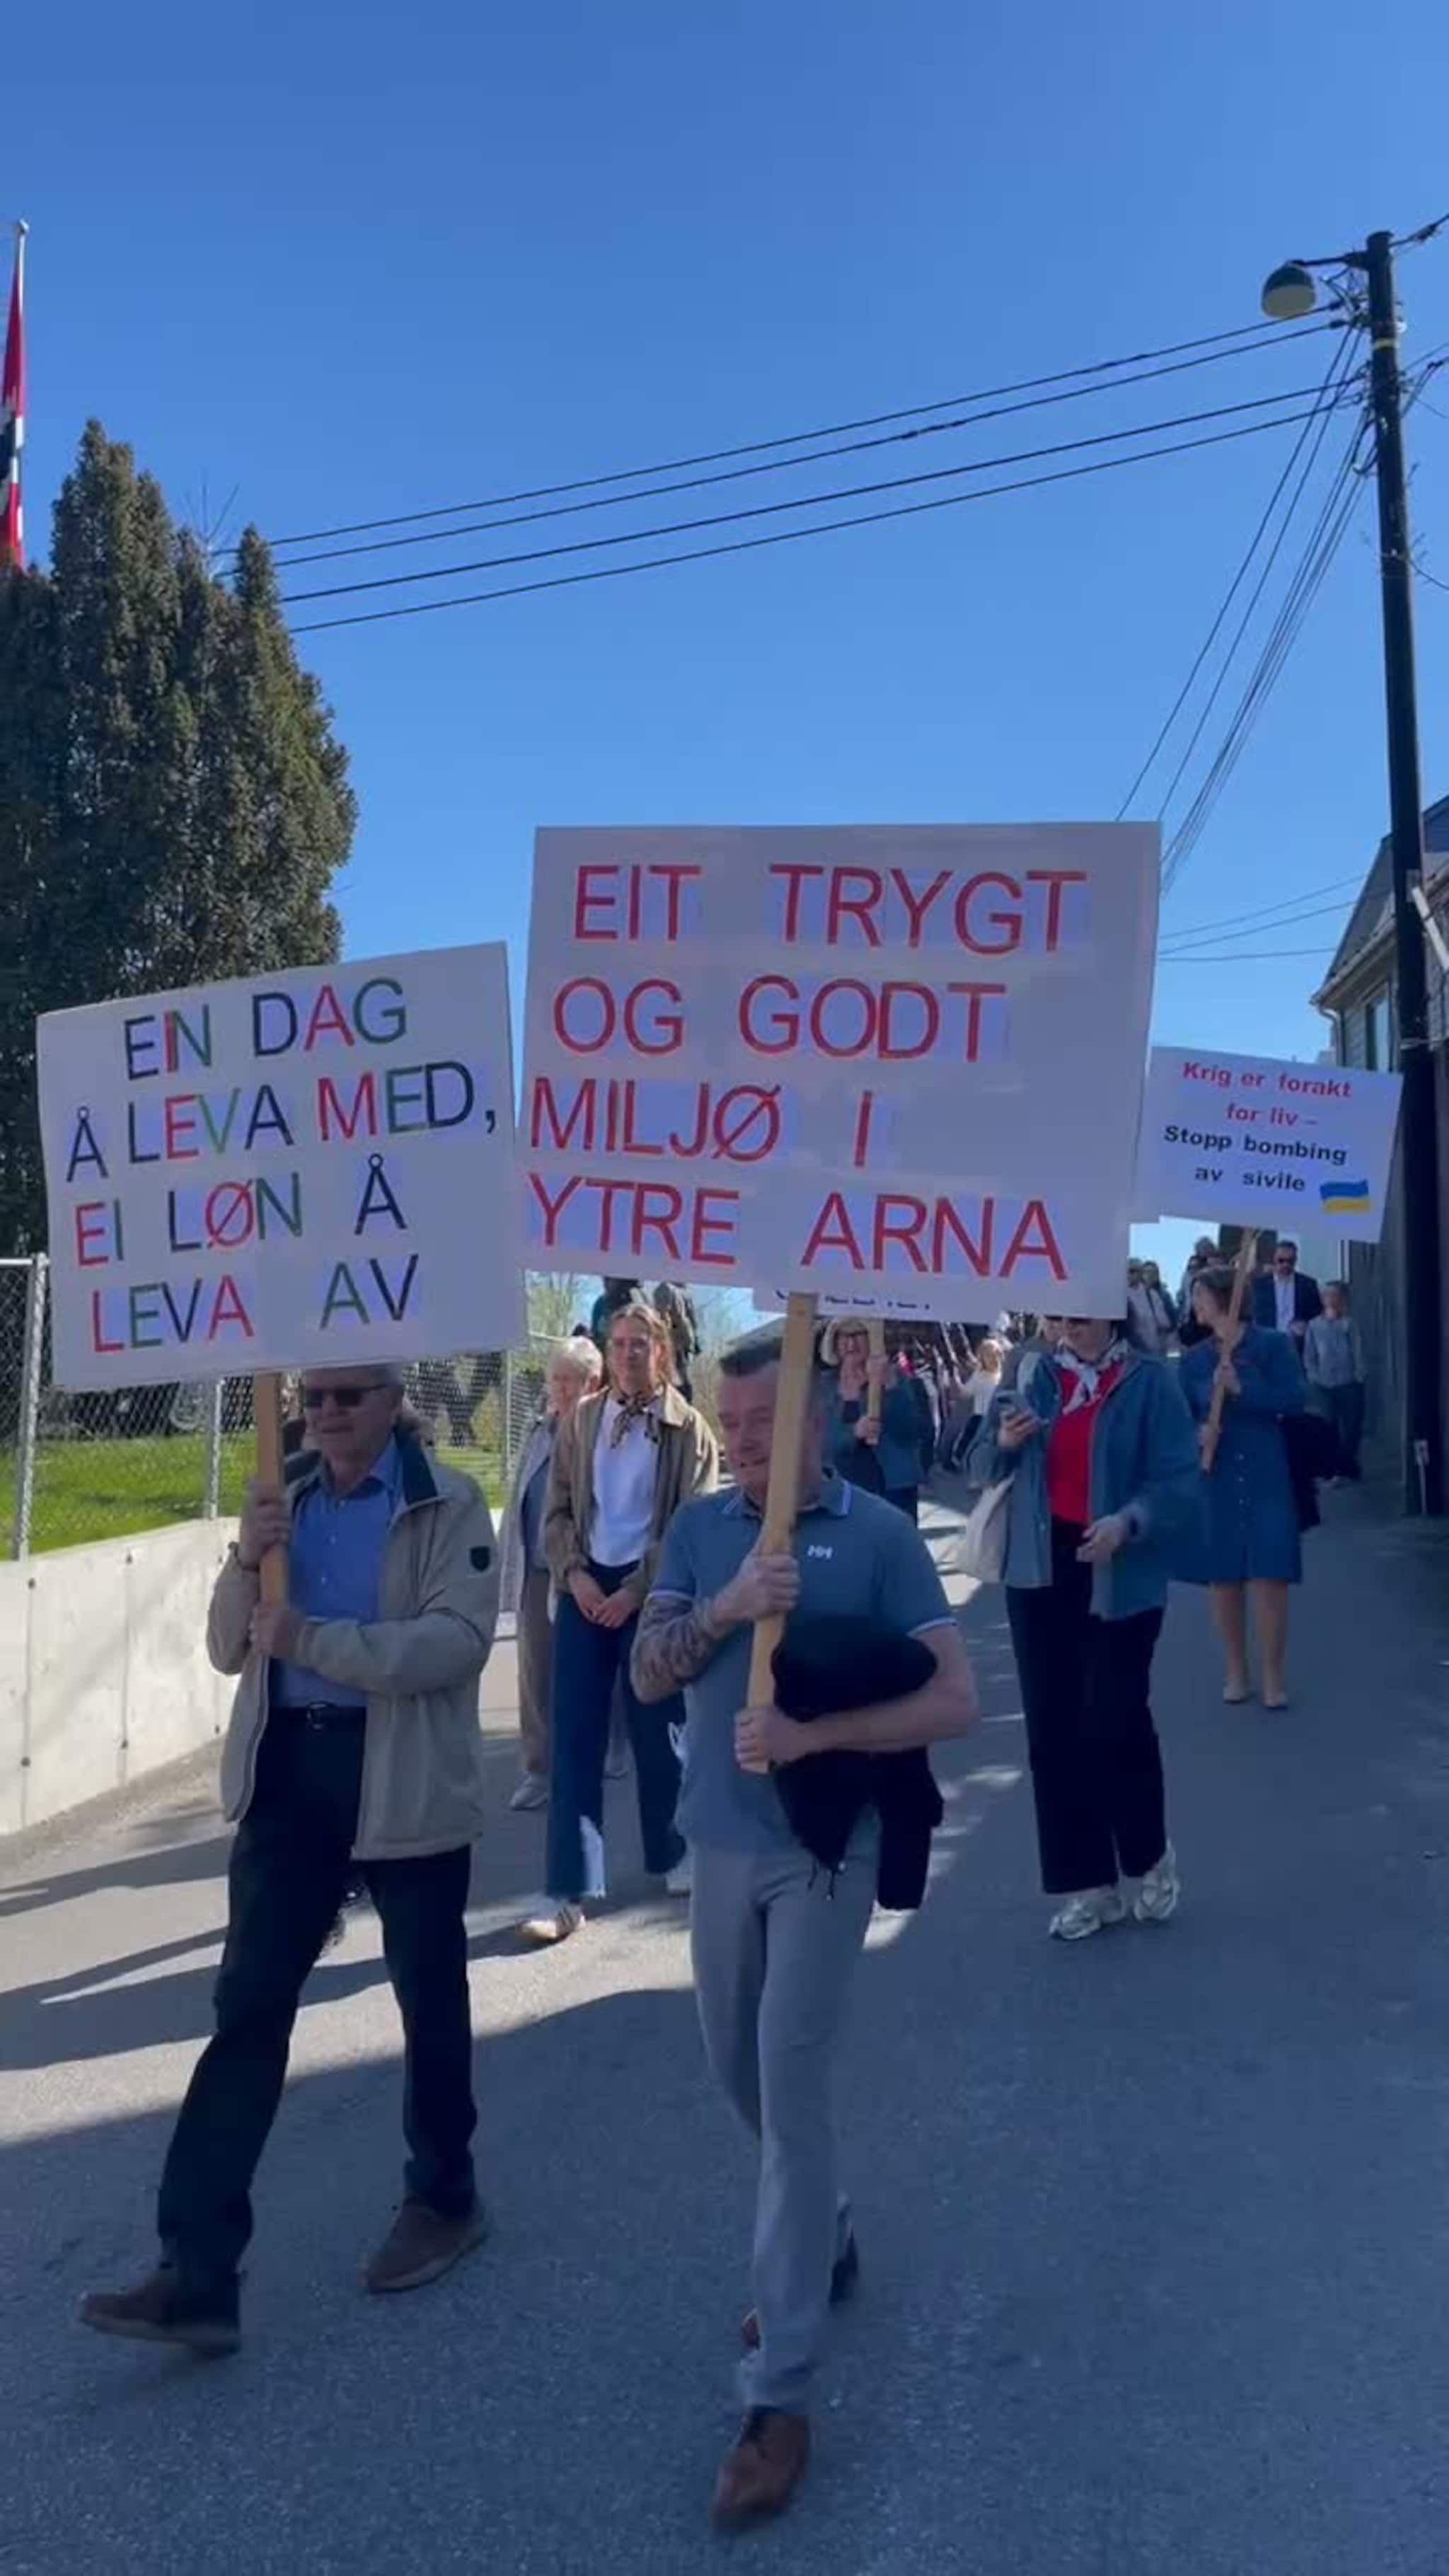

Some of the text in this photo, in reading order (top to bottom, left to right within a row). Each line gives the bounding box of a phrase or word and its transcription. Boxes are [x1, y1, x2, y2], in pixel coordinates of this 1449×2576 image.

[573, 864, 1088, 956] EIT TRYGT
[123, 977, 408, 1082] EIN DAG
[552, 974, 1007, 1063] OG GODT
[66, 1061, 496, 1182] Å LEVA MED,
[530, 1076, 874, 1169] MILJØ I
[1182, 1061, 1353, 1098] Krig er forakt
[1225, 1102, 1261, 1125] for
[1269, 1107, 1299, 1126] liv
[1163, 1125, 1348, 1166] Stopp bombing
[1194, 1166, 1305, 1192] av sivile
[75, 1153, 408, 1268] EI LØN Å
[527, 1172, 1069, 1281] YTRE ARNA
[91, 1253, 420, 1353] LEVA AV
